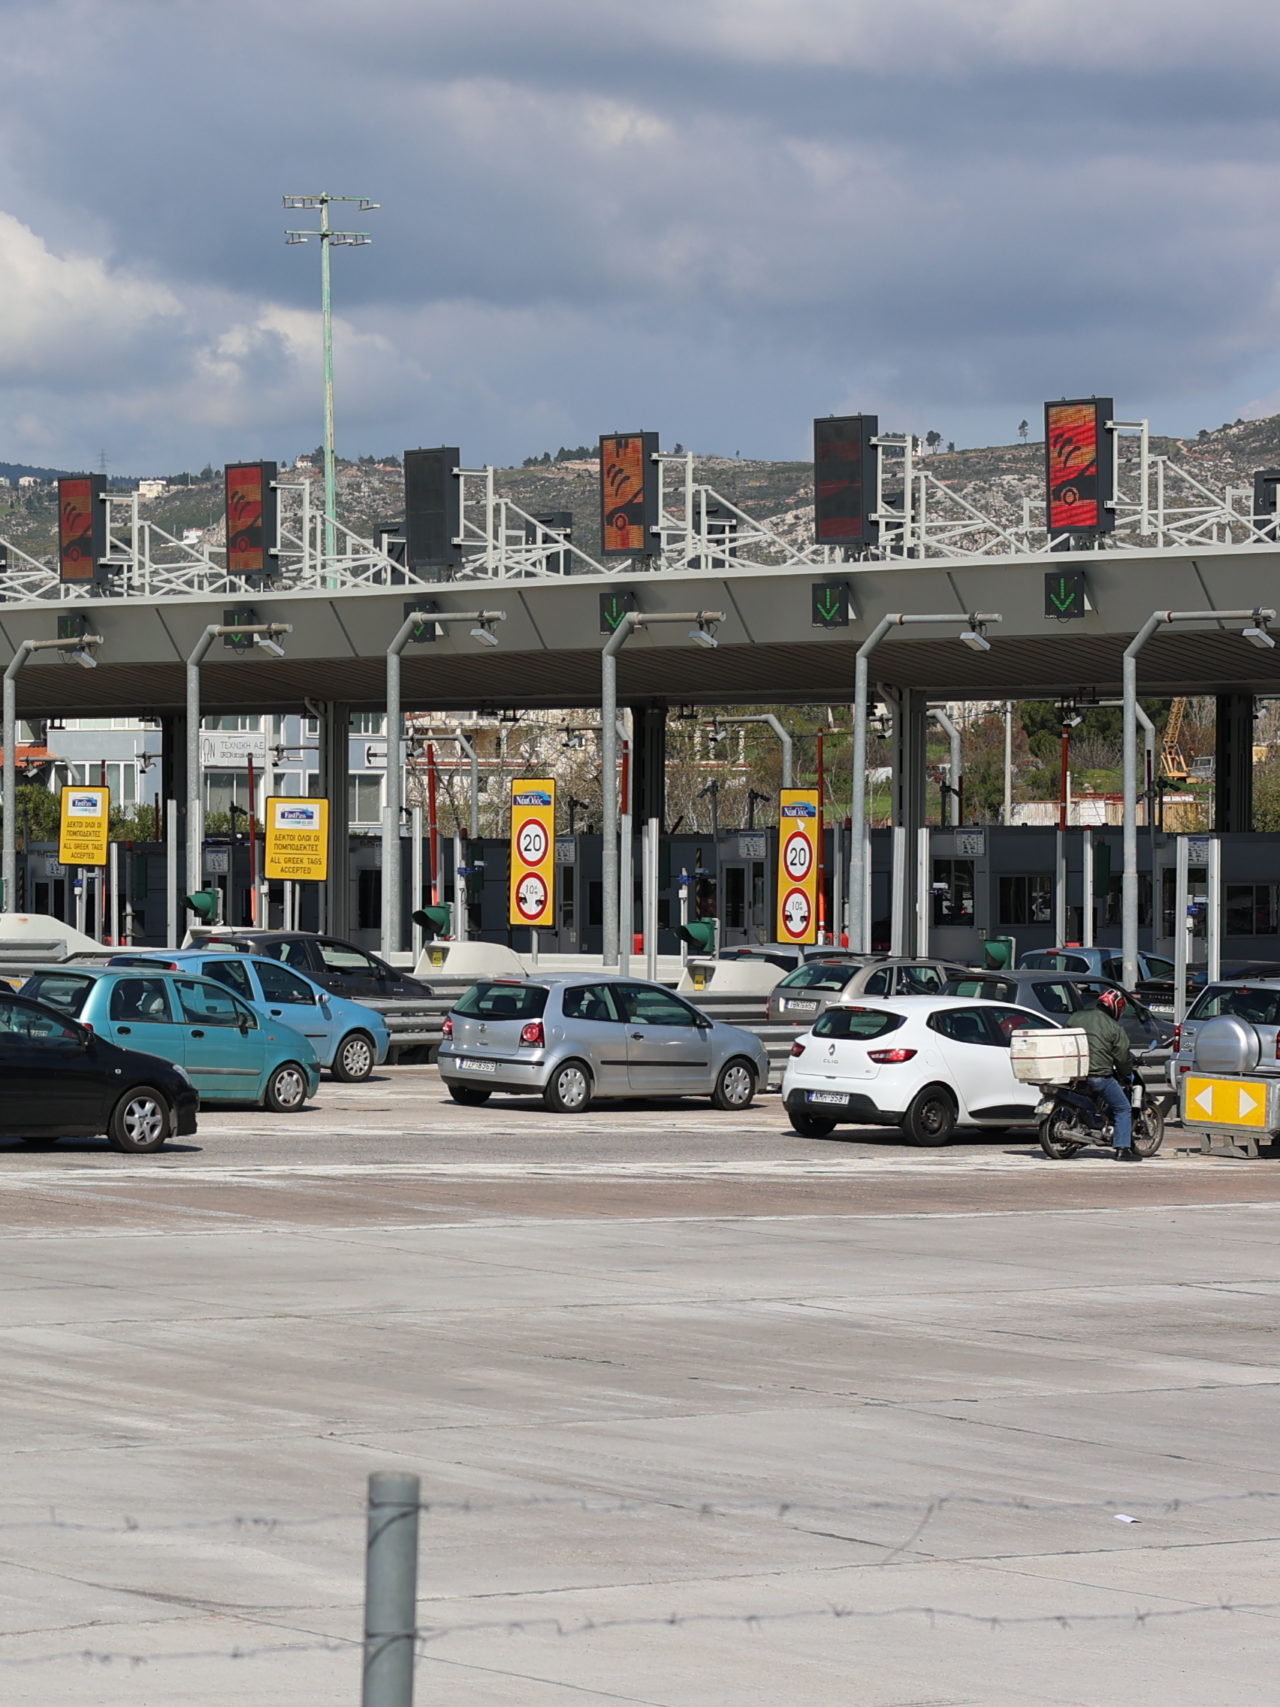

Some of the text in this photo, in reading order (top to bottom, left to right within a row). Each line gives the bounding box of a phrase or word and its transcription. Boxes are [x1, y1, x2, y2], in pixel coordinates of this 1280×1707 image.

[274, 834, 296, 842] ΔΕΚΤΟΙ
[63, 842, 73, 850] ALL
[74, 842, 90, 850] GREEK
[523, 833, 542, 852] 20
[70, 852, 95, 860] ACCEPTED
[789, 847, 807, 867] 20
[270, 856, 322, 866] ALL GREEK TAGS
[280, 866, 312, 874] ACCEPTED
